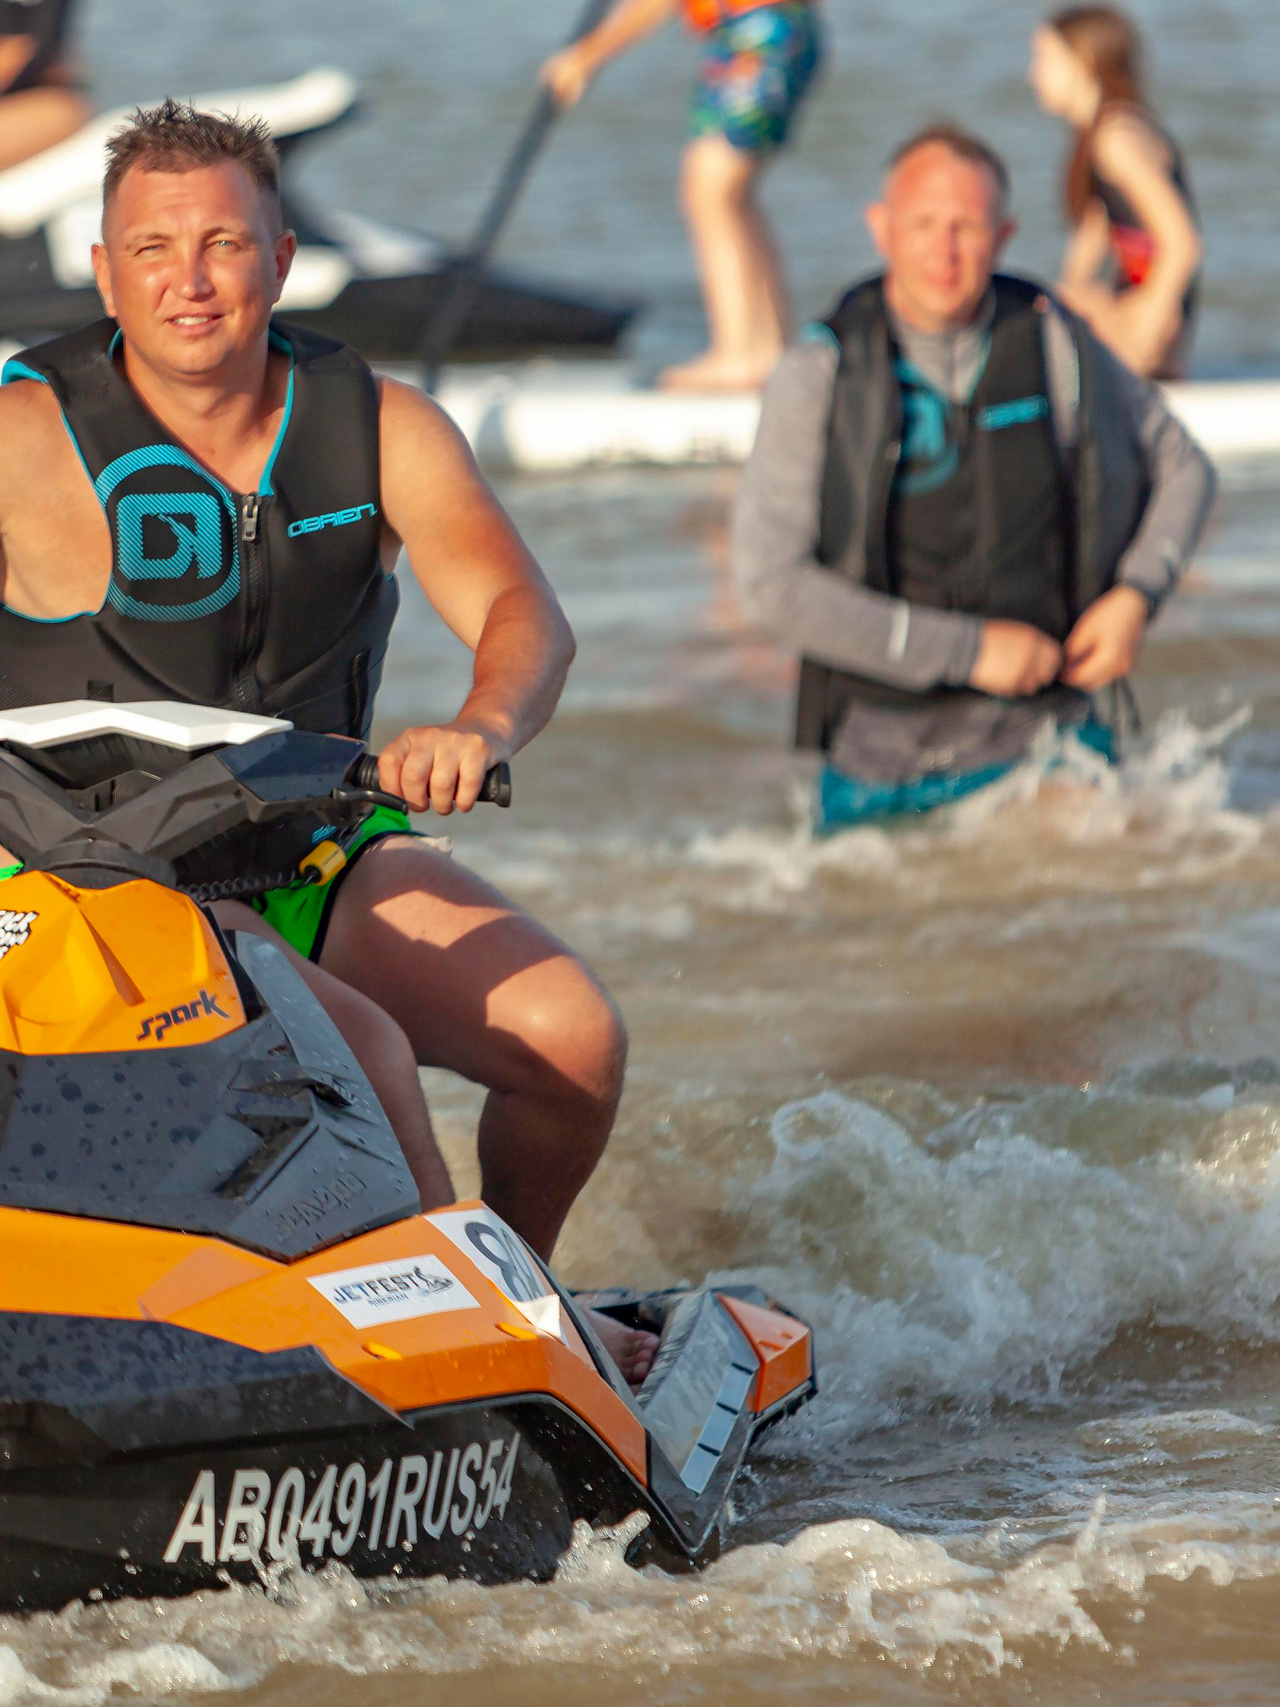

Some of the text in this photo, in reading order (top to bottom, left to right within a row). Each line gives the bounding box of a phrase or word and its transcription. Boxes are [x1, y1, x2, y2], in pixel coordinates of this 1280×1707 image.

[287, 502, 378, 538] OBRIEN
[137, 989, 230, 1042] spark
[333, 1272, 420, 1305] JETFEST
[367, 1293, 410, 1309] SIBERIAN
[163, 1431, 521, 1564] AB0491RUS54
